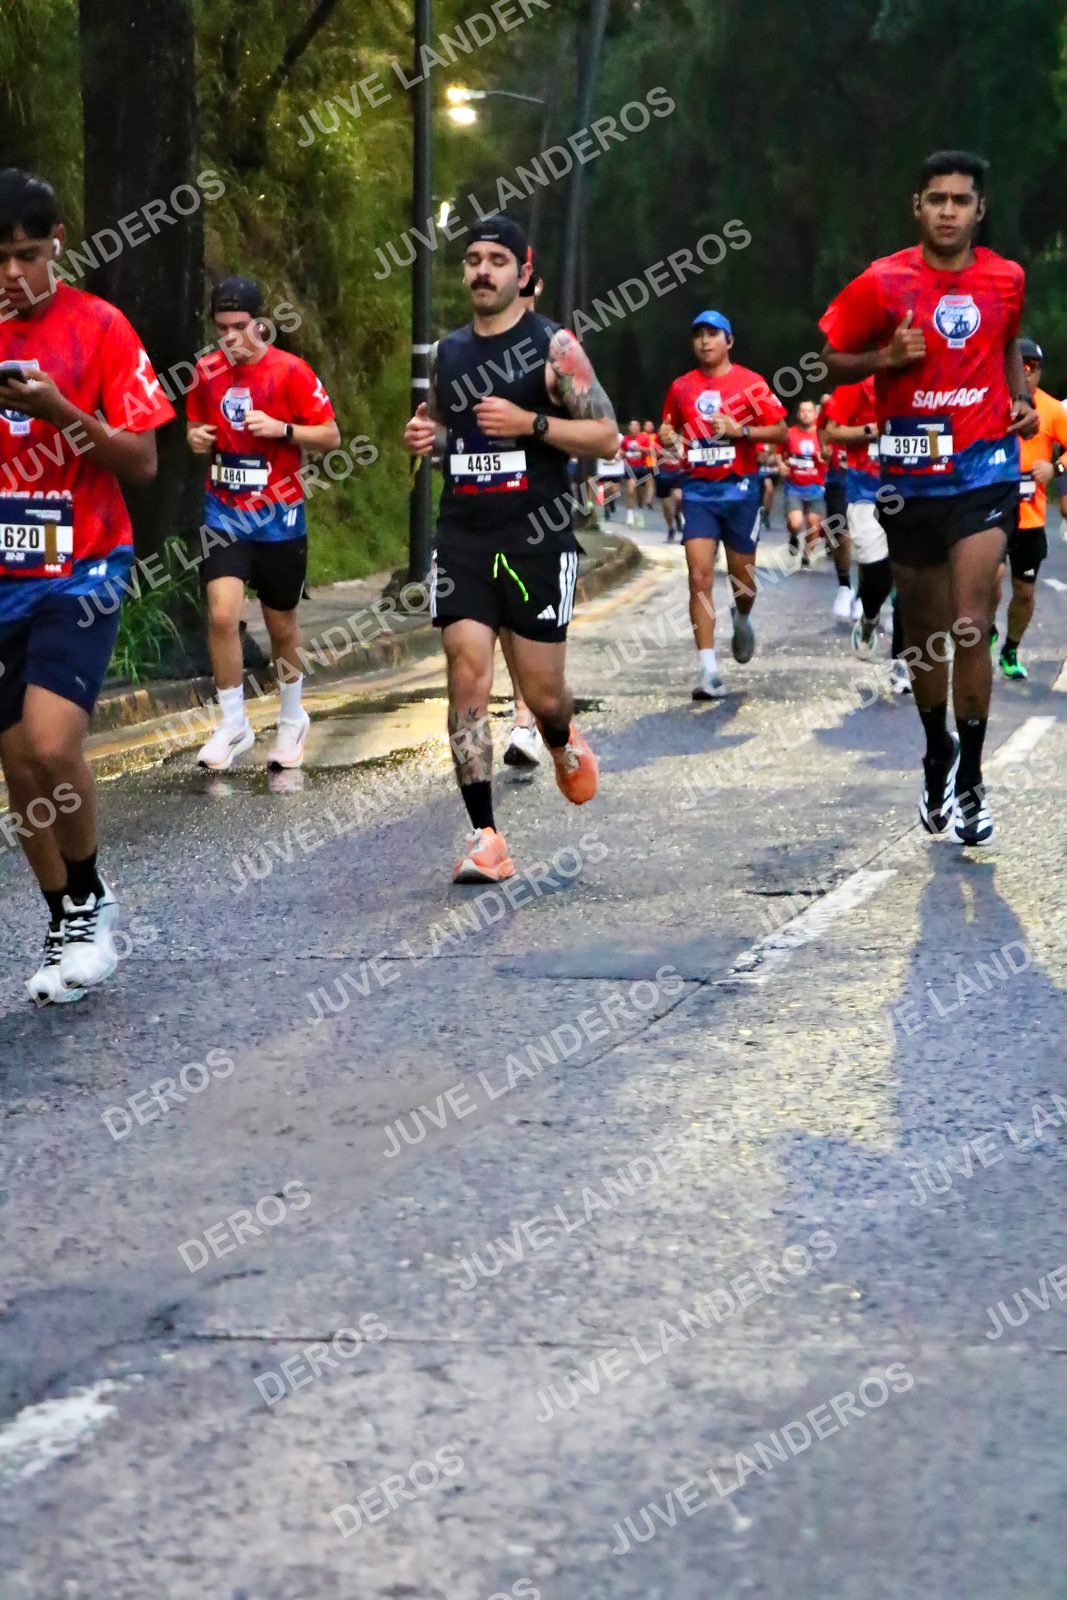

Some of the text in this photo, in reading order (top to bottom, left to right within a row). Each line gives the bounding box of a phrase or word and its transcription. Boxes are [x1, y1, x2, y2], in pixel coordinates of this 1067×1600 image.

[895, 438, 928, 454] 3979
[468, 454, 501, 472] 4435
[223, 469, 247, 482] 4841
[0, 527, 40, 549] 620
